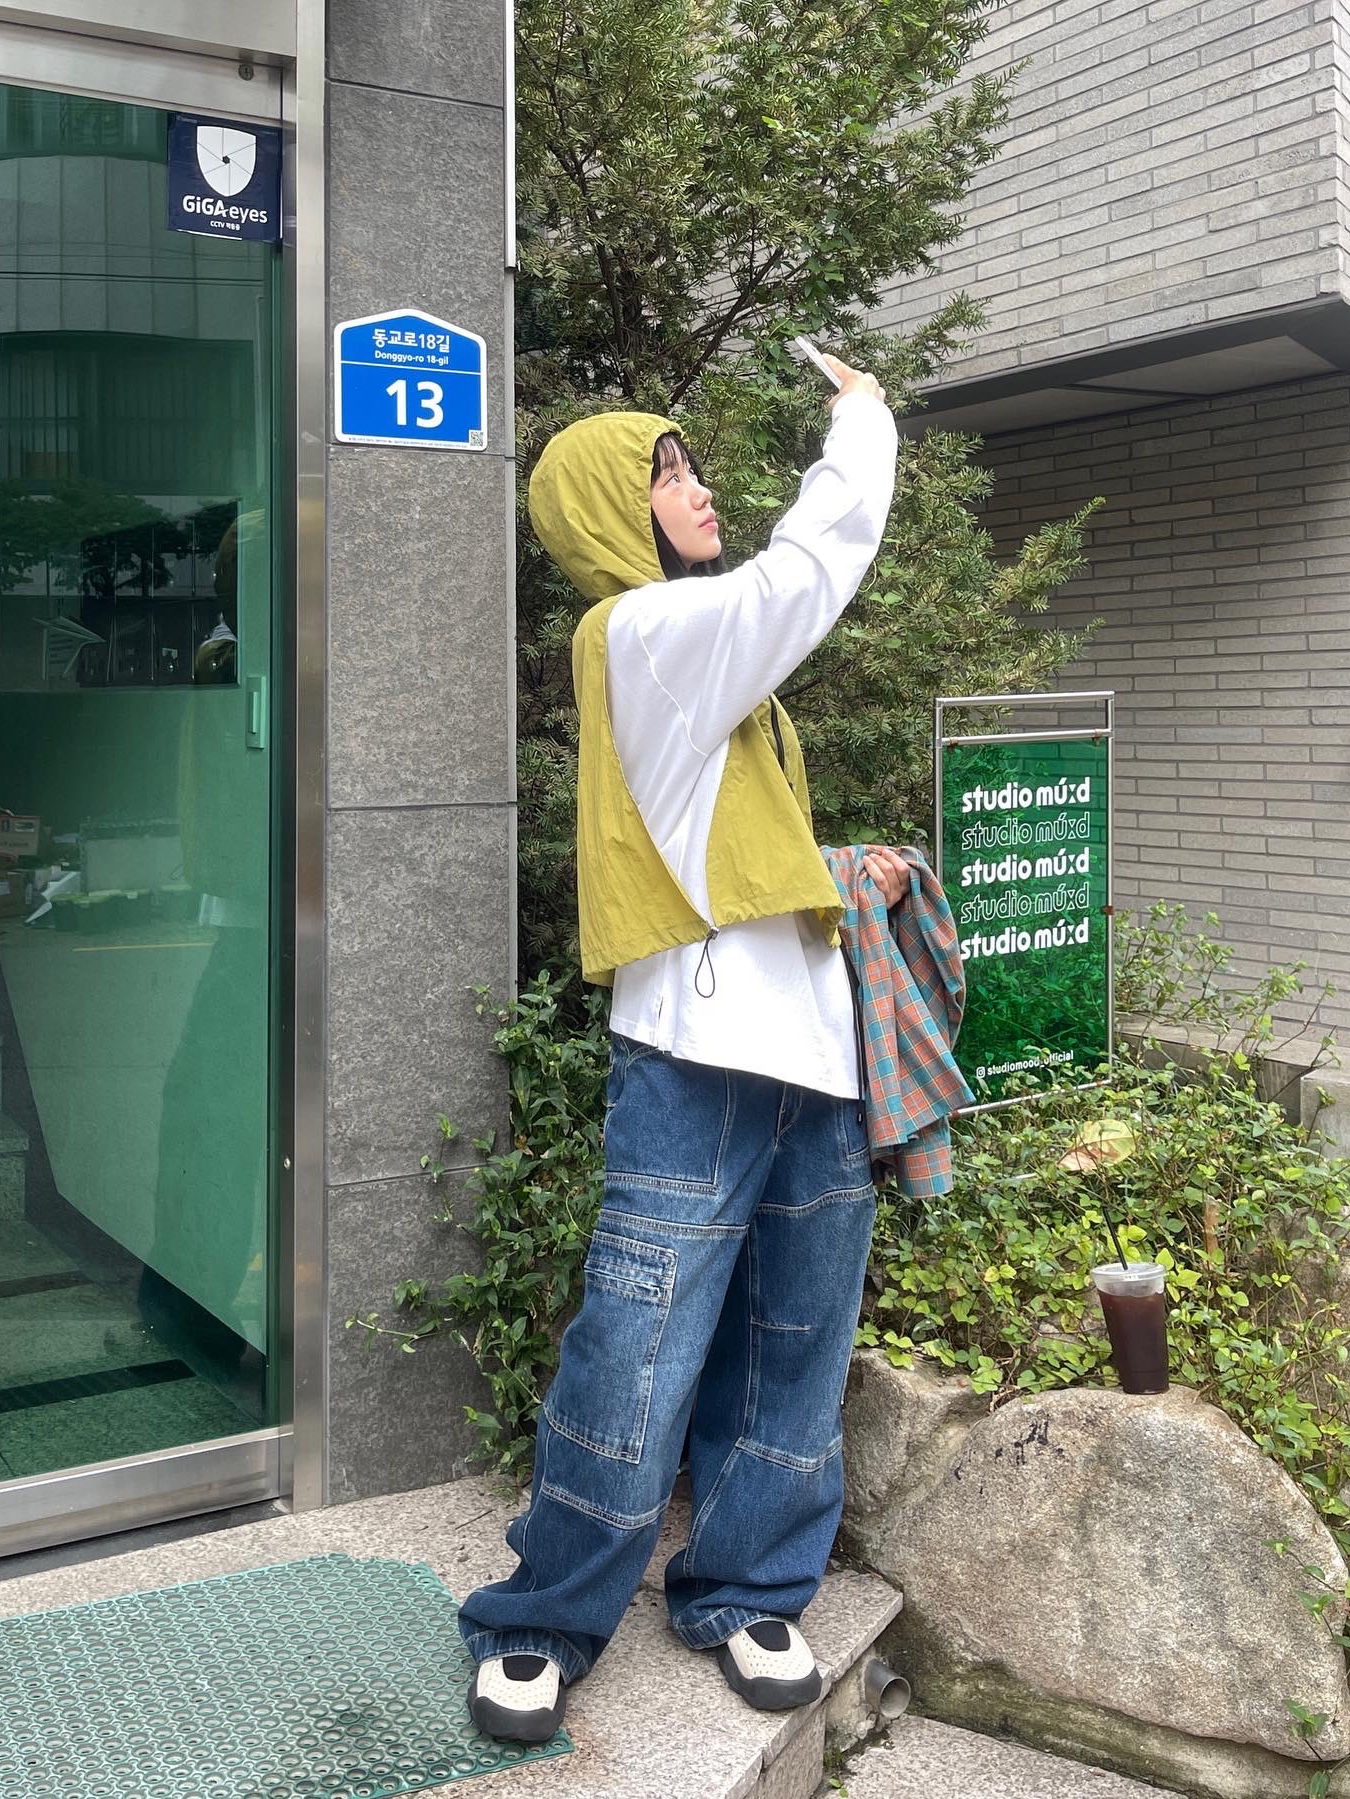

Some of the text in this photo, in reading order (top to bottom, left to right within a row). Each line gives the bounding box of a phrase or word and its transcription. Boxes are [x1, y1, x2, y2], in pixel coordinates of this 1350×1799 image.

[210, 220, 225, 228] CCTV
[372, 328, 450, 353] 동교로18길
[374, 350, 449, 366] Donggyo-ro 18-gil
[386, 379, 444, 429] 13
[962, 781, 1032, 813] studio
[961, 818, 1032, 850] studio
[961, 855, 1032, 887] studio
[960, 891, 1032, 924] studio
[960, 927, 1031, 960] studio
